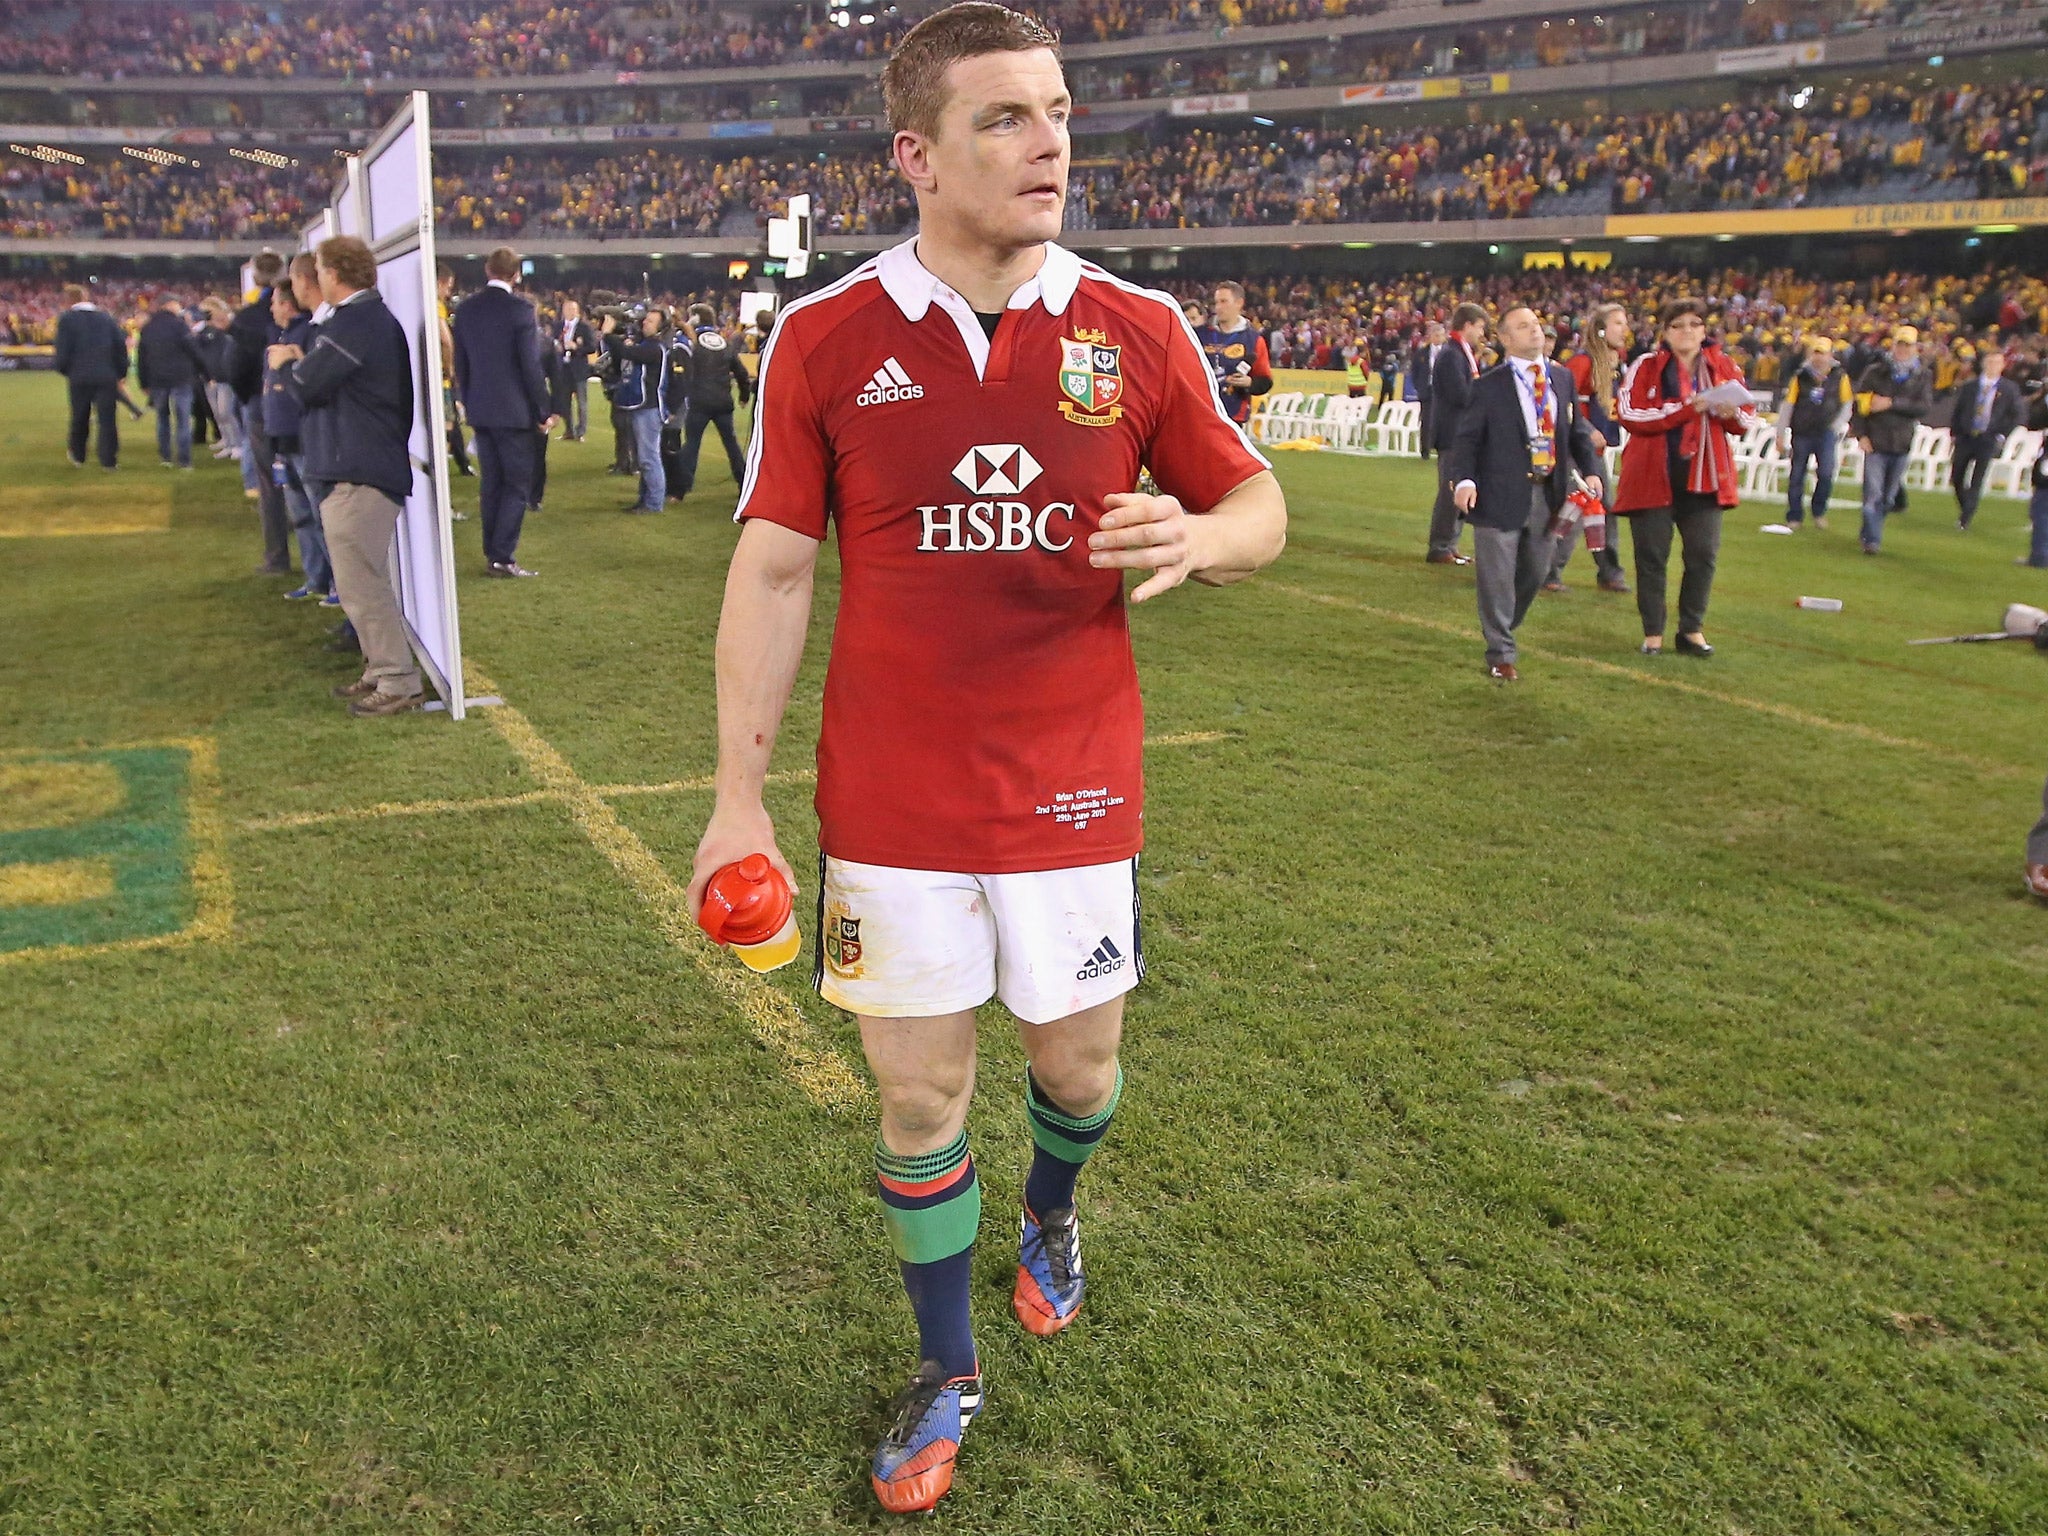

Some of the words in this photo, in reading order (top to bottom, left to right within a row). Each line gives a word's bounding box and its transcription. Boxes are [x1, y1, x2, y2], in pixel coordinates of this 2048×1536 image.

[856, 385, 924, 406] adidas
[1068, 413, 1101, 424] AUSTRALIA
[916, 501, 1075, 552] HSBC
[1035, 806, 1050, 814] 2nd
[1052, 804, 1068, 813] Test
[1070, 799, 1100, 811] Australia
[1107, 796, 1124, 806] Lions
[1056, 792, 1074, 802] Brian
[1056, 814, 1072, 823] 29th
[1073, 811, 1090, 821] June
[1091, 808, 1106, 817] 2013
[1074, 820, 1088, 830] 697
[1076, 955, 1126, 981] adidas
